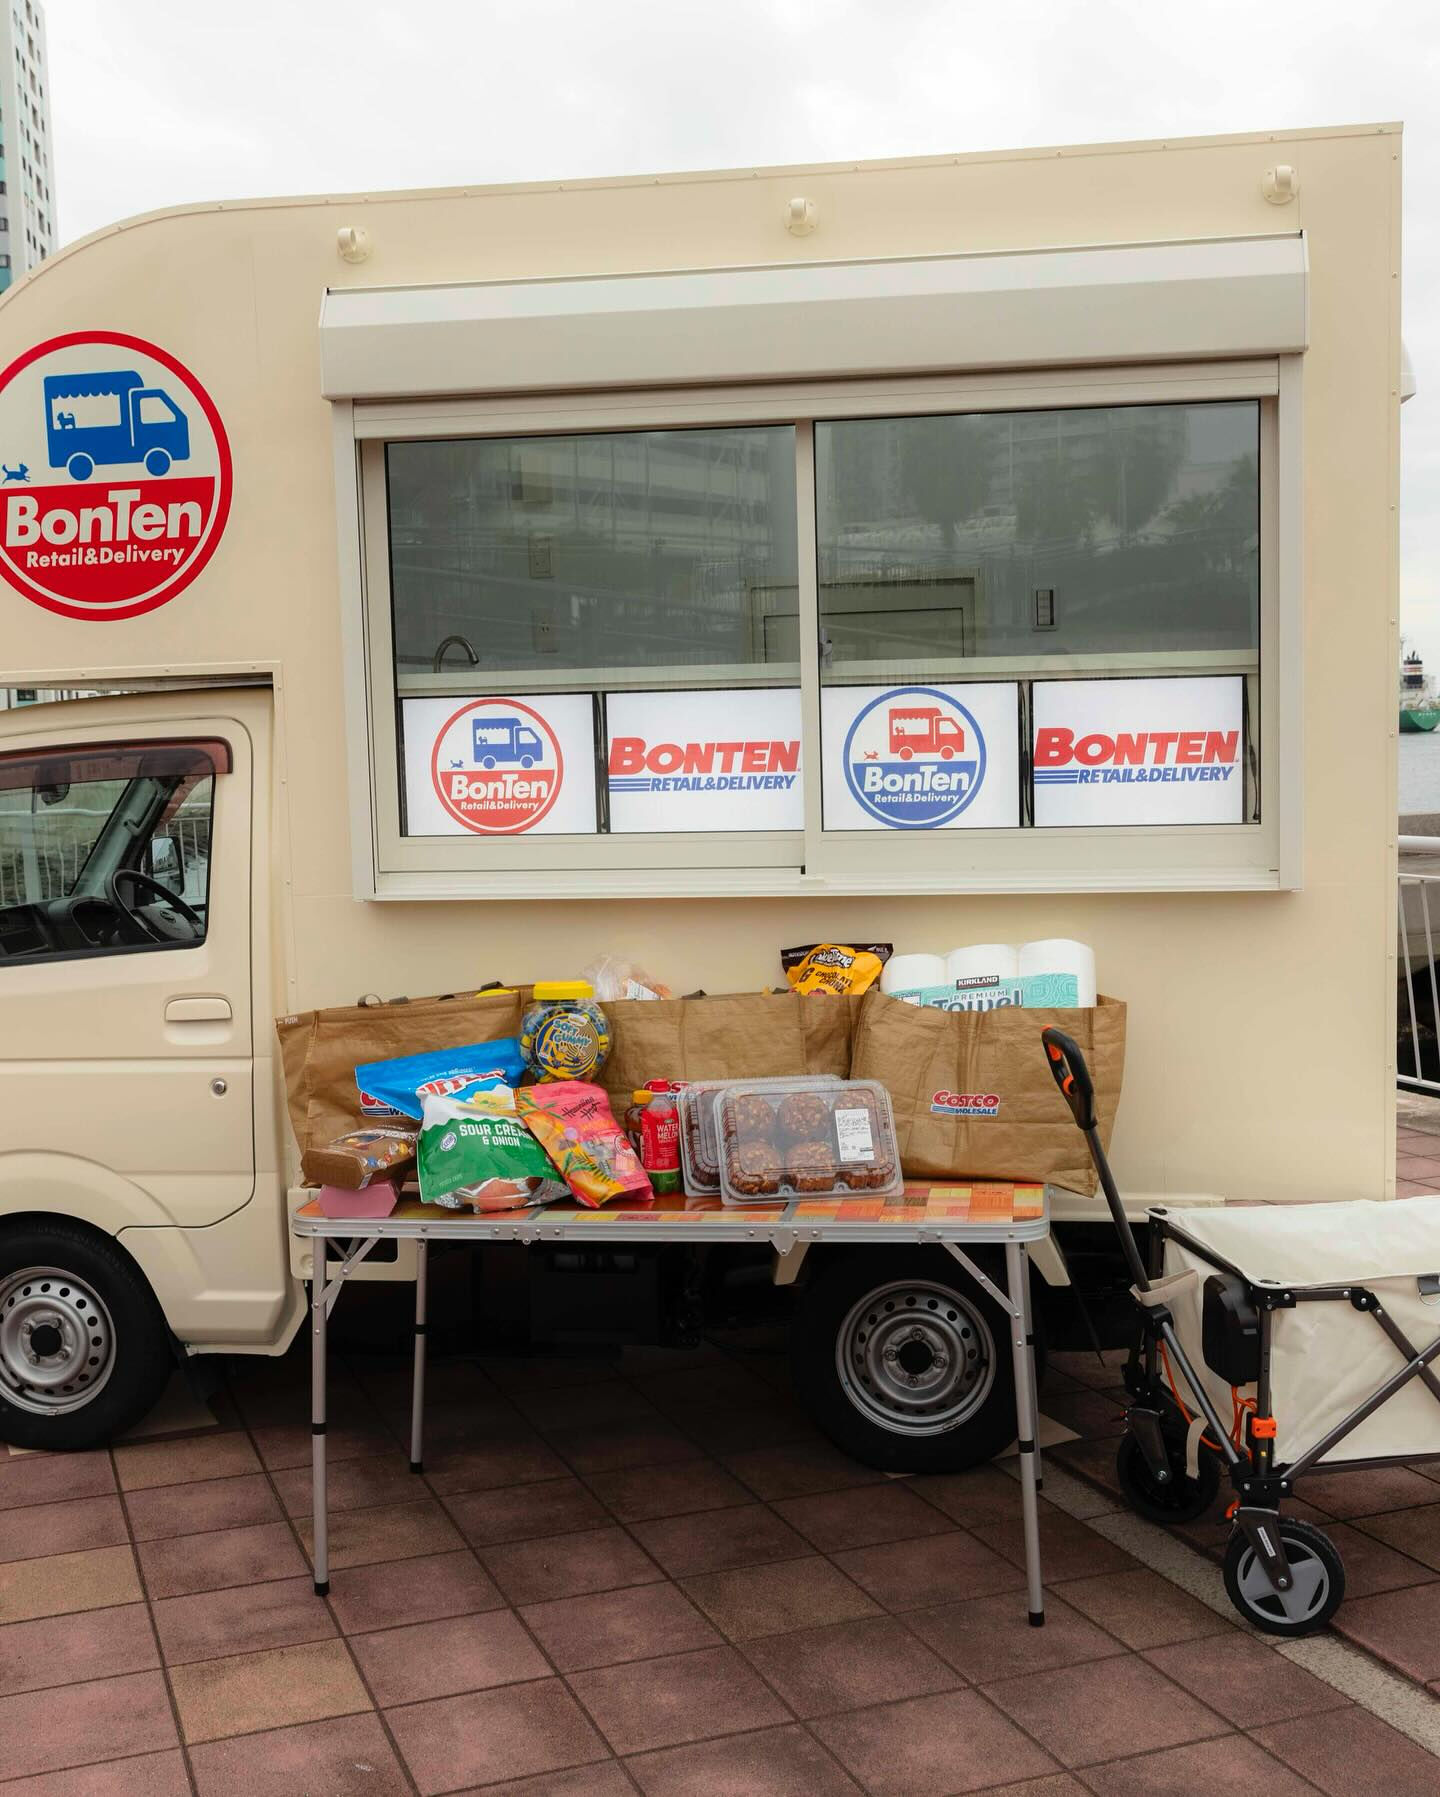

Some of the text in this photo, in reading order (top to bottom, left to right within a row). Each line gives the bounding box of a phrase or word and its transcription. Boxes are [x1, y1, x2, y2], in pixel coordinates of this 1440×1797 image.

[5, 488, 202, 548] BonTen
[26, 545, 185, 568] Retail&Delivery
[608, 737, 801, 775] BONTEN
[1034, 728, 1239, 767] BONTEN
[649, 775, 796, 792] RETAIL&DELIVERY
[863, 764, 970, 793] BonTen
[1076, 766, 1234, 784] RETAIL&DELIVERY
[451, 774, 549, 801] BonTen
[460, 800, 540, 812] Retail&Delivery
[874, 792, 960, 804] Retail&Delivery
[958, 976, 998, 987] KIRKLAND
[953, 989, 1007, 1001] PREMIUM
[459, 1124, 492, 1137] SOUR
[482, 1136, 521, 1147] & ONION
